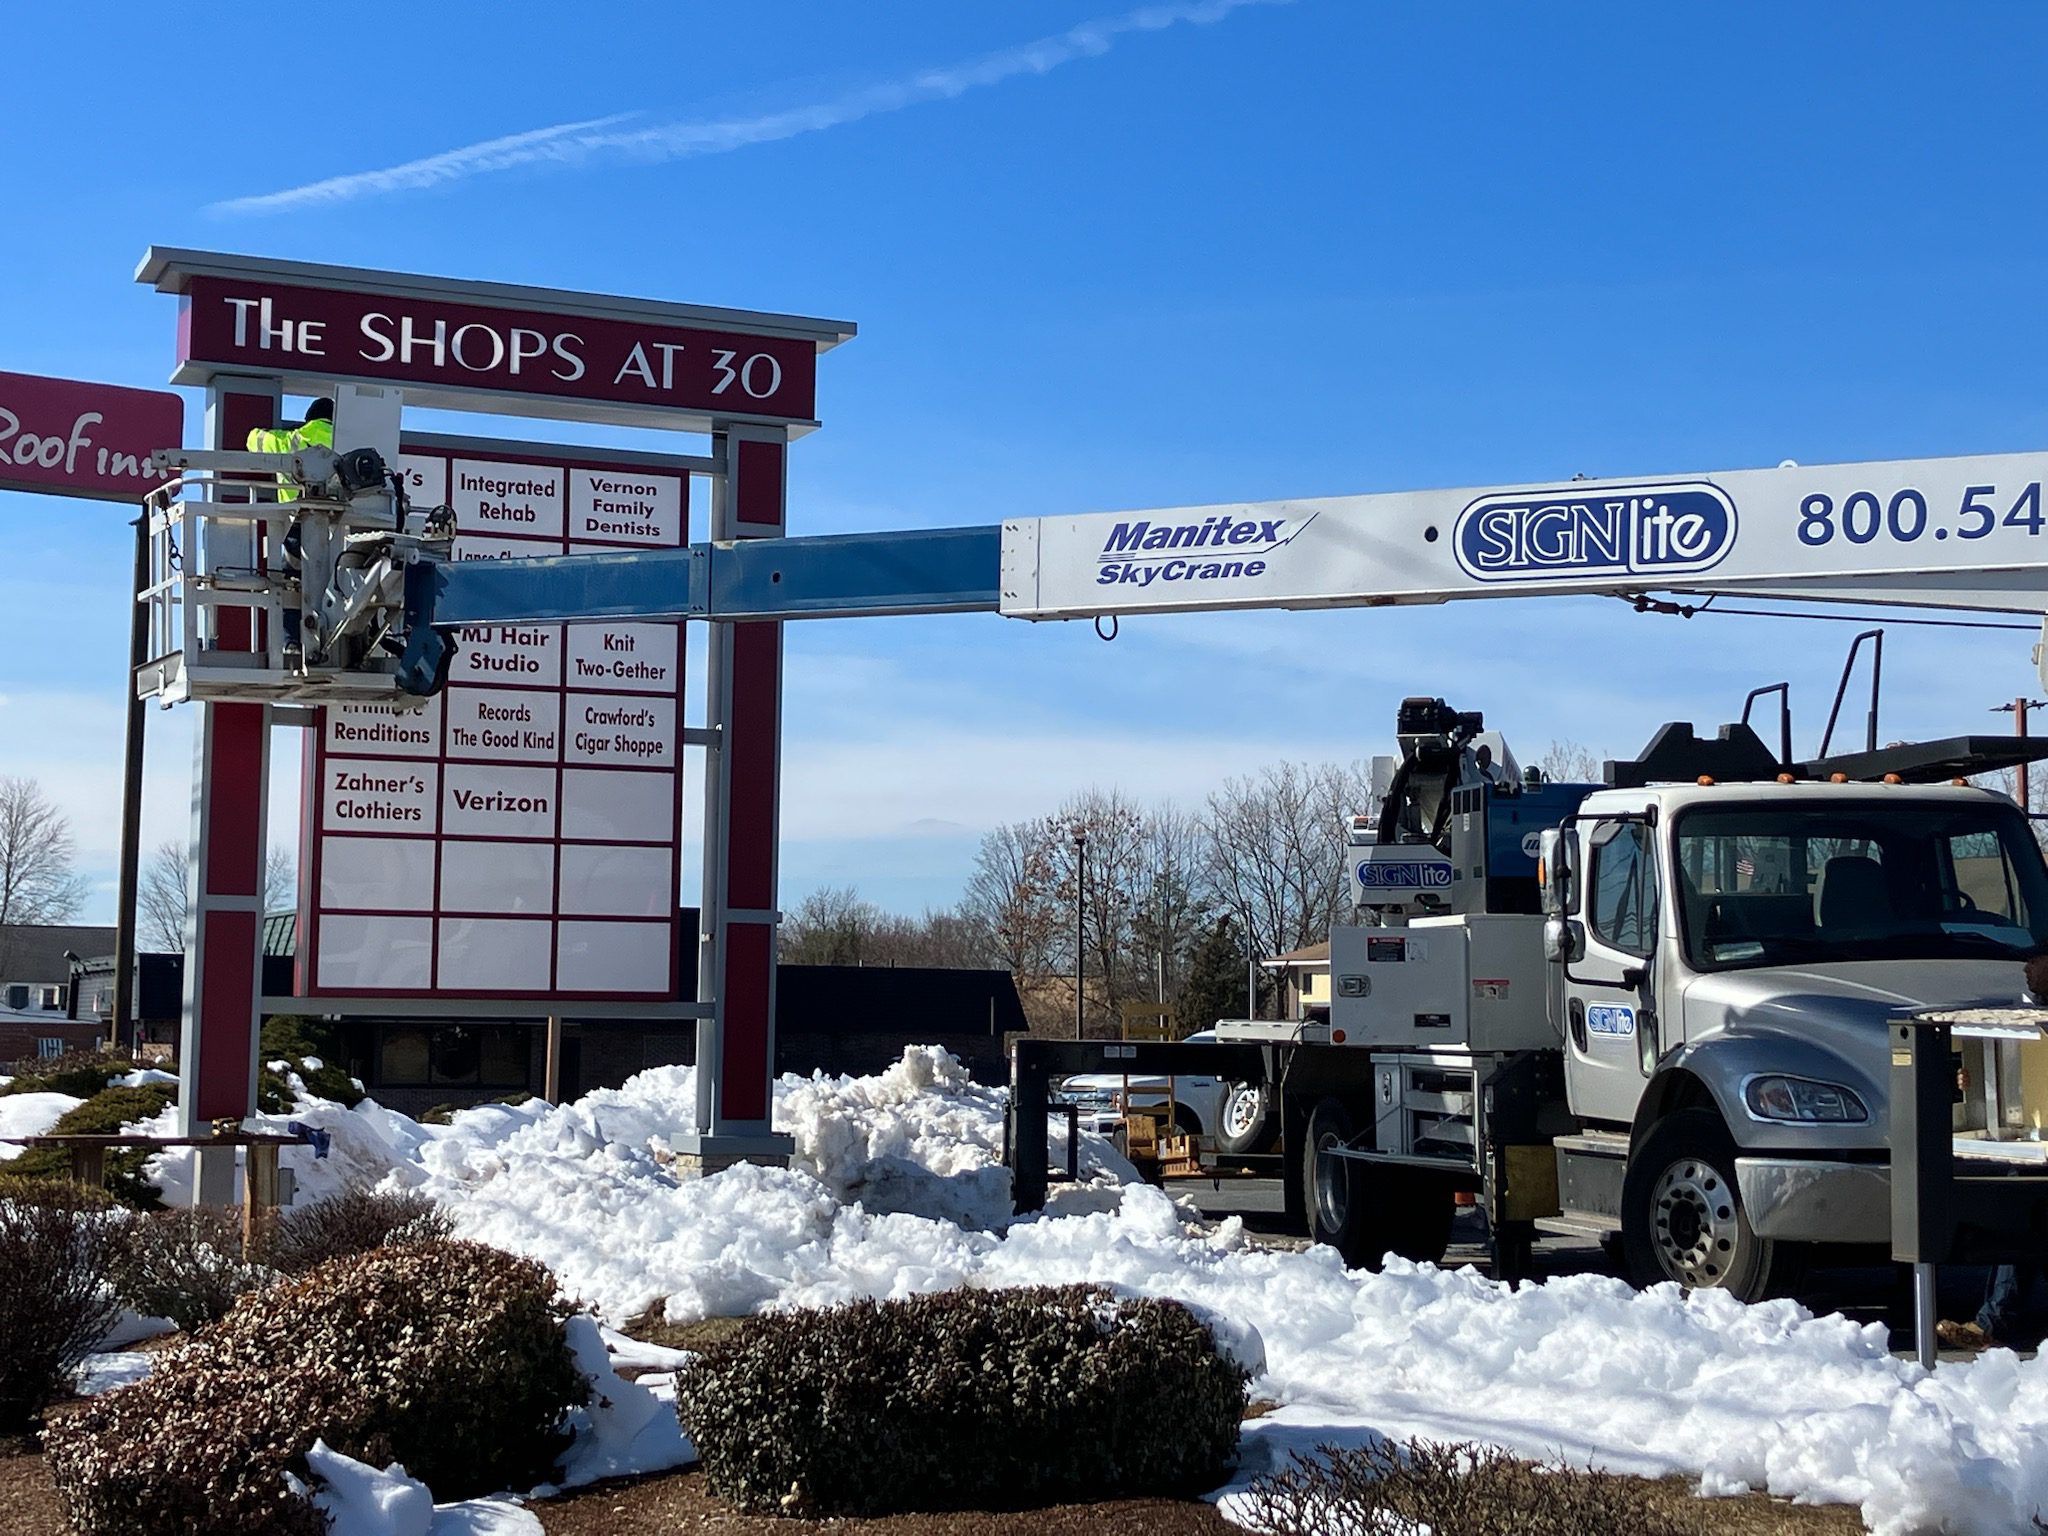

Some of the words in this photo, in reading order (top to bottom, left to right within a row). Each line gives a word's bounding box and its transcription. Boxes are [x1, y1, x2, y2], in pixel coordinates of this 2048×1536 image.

[359, 312, 586, 382] SHOPS
[614, 342, 684, 389] AT
[711, 349, 782, 399] 30
[461, 473, 555, 498] Integrated
[590, 478, 657, 497] Vernon
[480, 502, 535, 522] Rehab
[592, 498, 655, 520] Family
[1797, 482, 2046, 546] 800.54
[585, 518, 661, 538] Dentists
[1103, 516, 1286, 552] Manitex
[1096, 560, 1266, 587] SkyCrane
[462, 628, 491, 643] MJ
[501, 627, 550, 647] Hair
[604, 634, 634, 651] Knit
[470, 652, 539, 672] Studio
[576, 659, 665, 679] Two-Gether
[479, 703, 530, 721] Records
[586, 707, 654, 727] Crawford's
[335, 722, 429, 743] Renditions
[453, 728, 477, 746] The
[482, 730, 518, 747] Good
[524, 732, 554, 749] Kind
[576, 733, 610, 755] Cigar
[615, 735, 663, 757] Shoppe
[335, 773, 424, 793] Zahner's
[336, 800, 421, 820] Clothiers
[453, 790, 547, 812] Verizon
